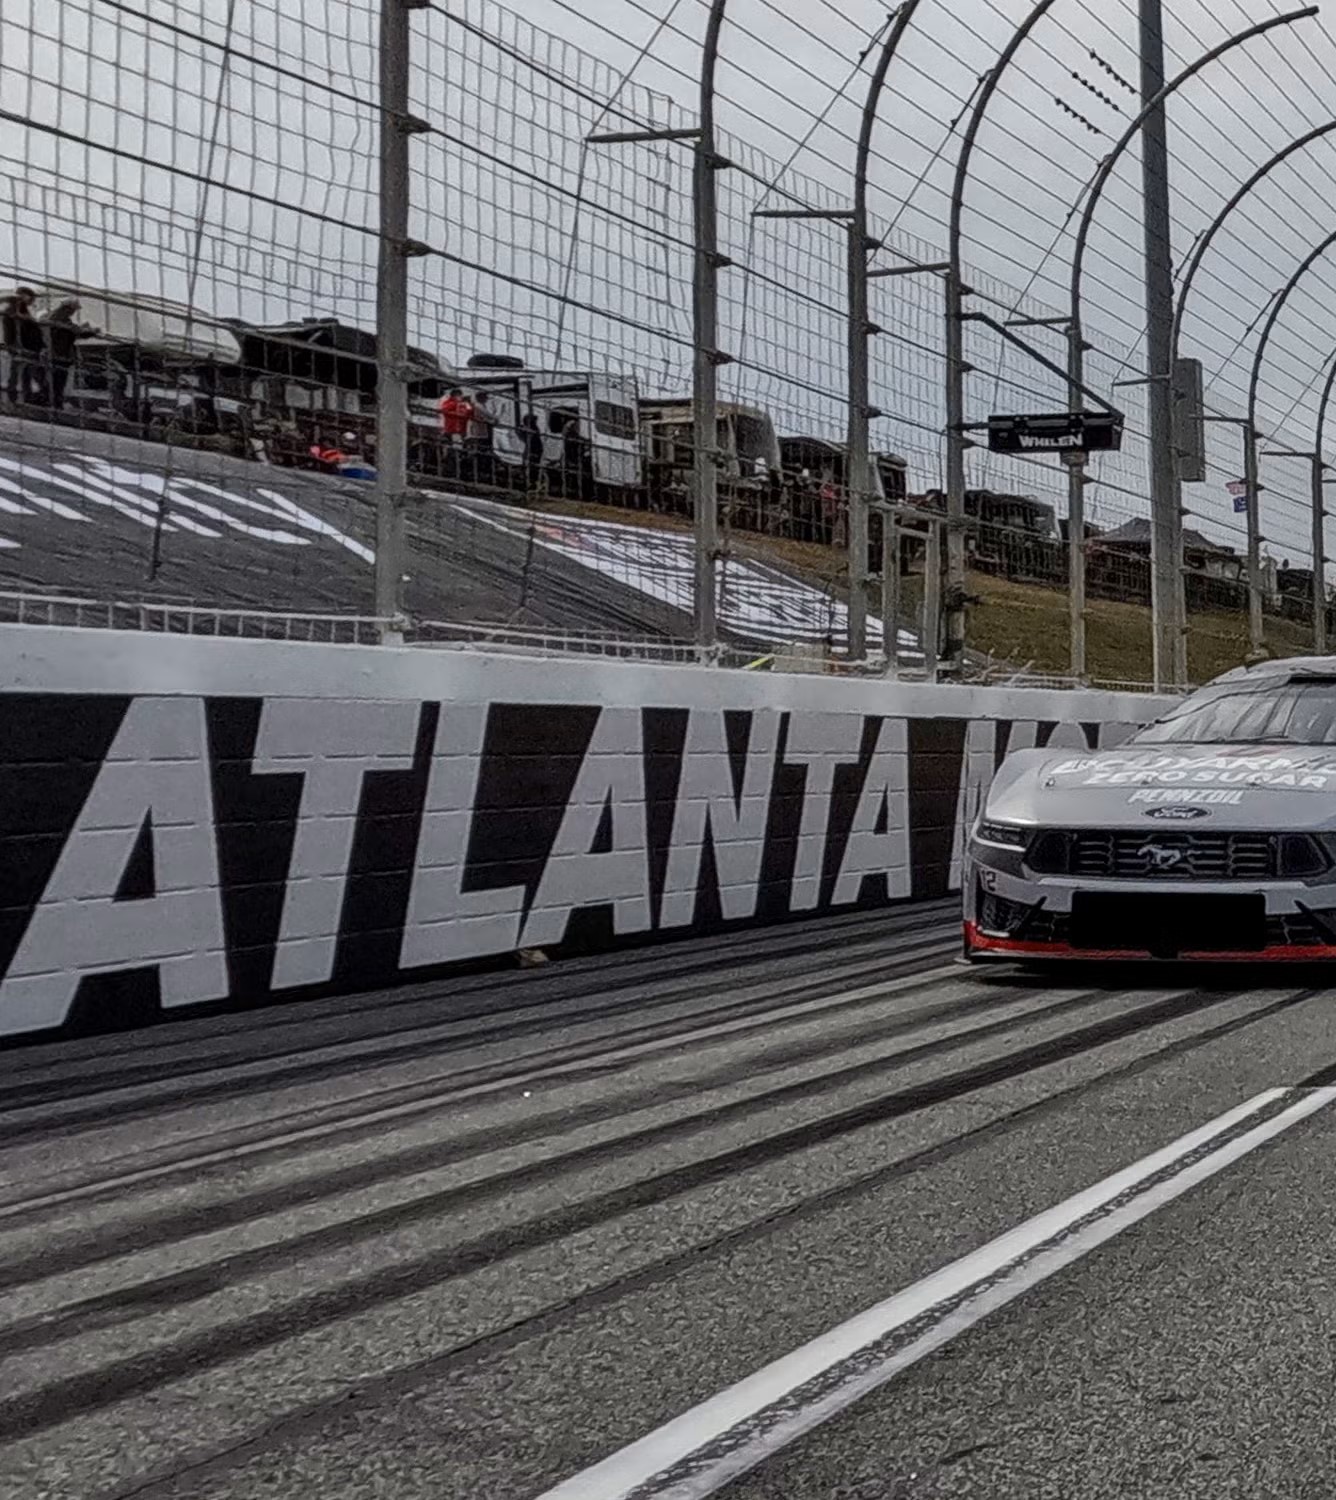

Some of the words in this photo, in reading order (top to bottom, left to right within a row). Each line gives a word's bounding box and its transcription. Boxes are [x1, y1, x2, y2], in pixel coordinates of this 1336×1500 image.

[1191, 770, 1328, 788] SUGAR
[1127, 788, 1244, 804] PENNZOIL
[2, 697, 912, 1036] ATLANTA
